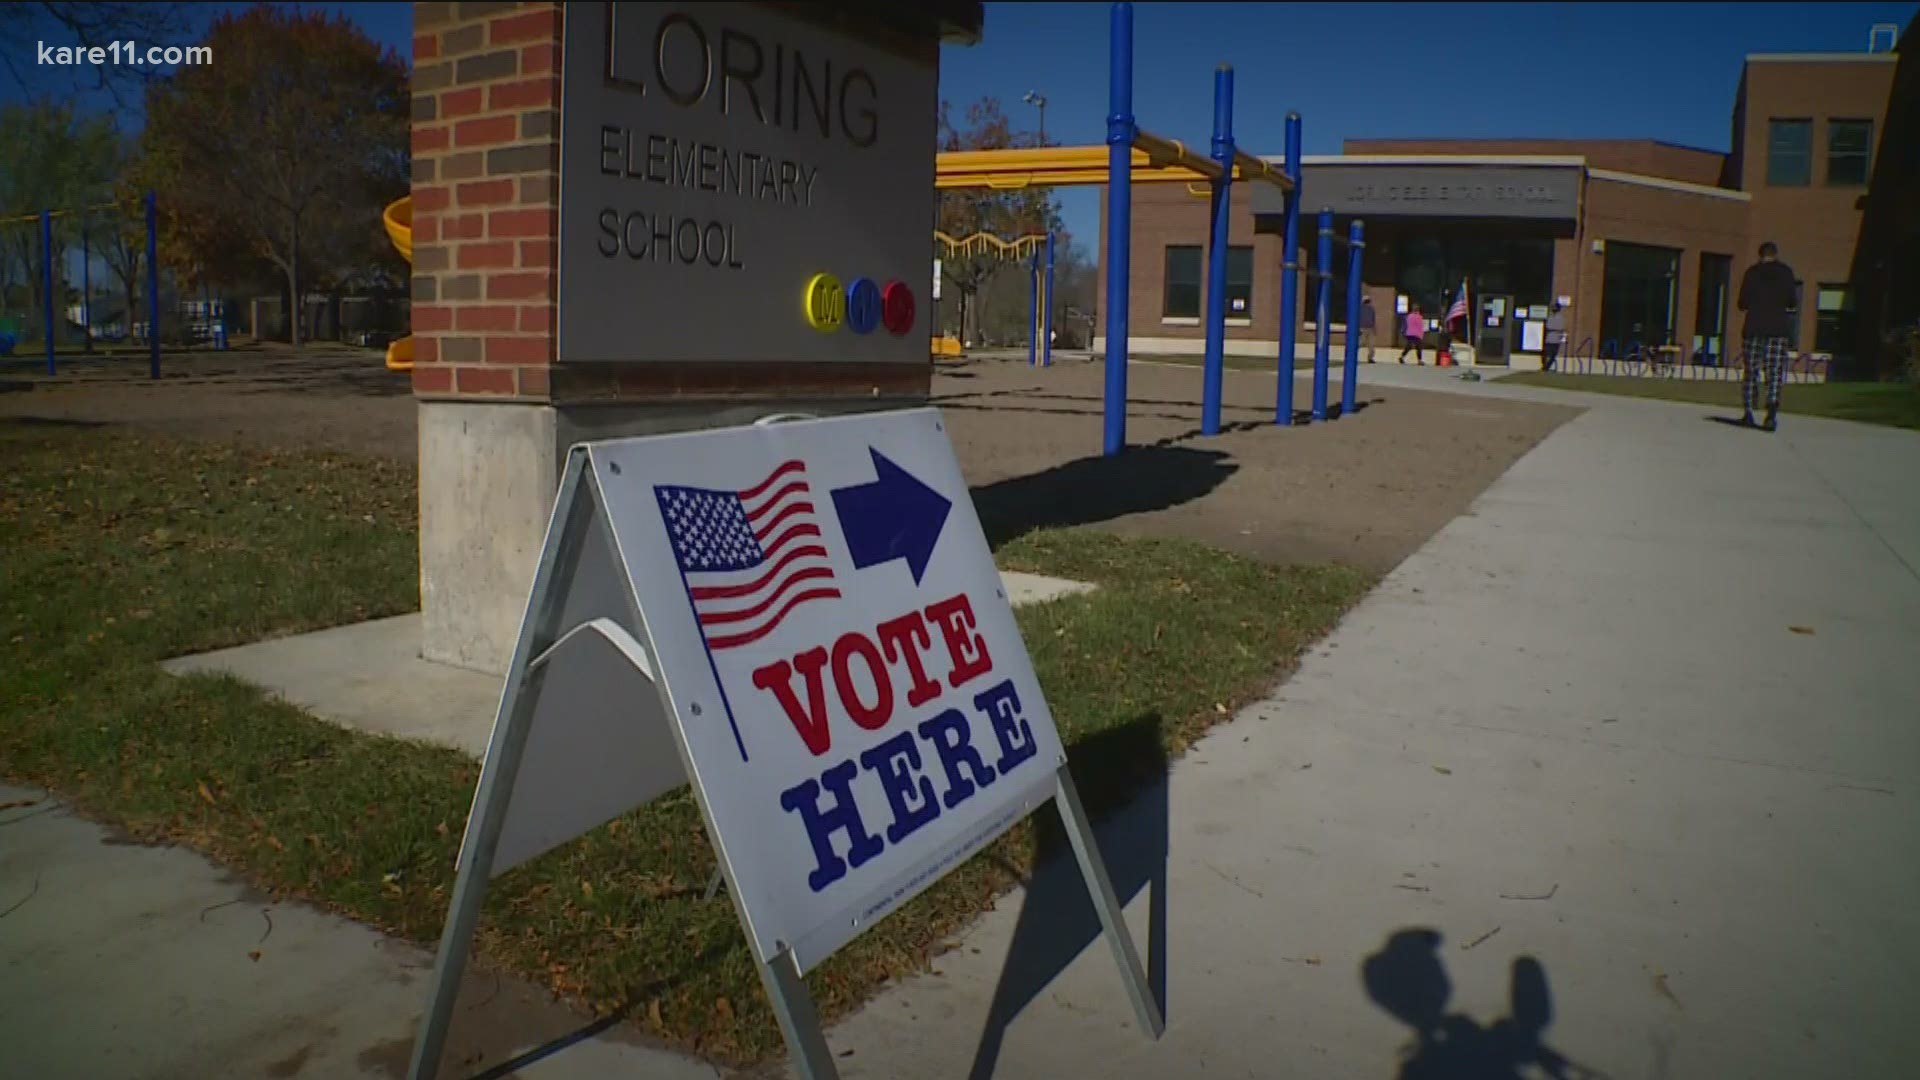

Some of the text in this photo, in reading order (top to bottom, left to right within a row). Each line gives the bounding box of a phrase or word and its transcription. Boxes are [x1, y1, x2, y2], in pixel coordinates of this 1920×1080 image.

[603, 2, 879, 148] LORING
[598, 207, 745, 270] SCHOOL
[600, 124, 818, 207] ELEMENTARY
[752, 593, 993, 756] VOTE
[780, 678, 1037, 892] HERE
